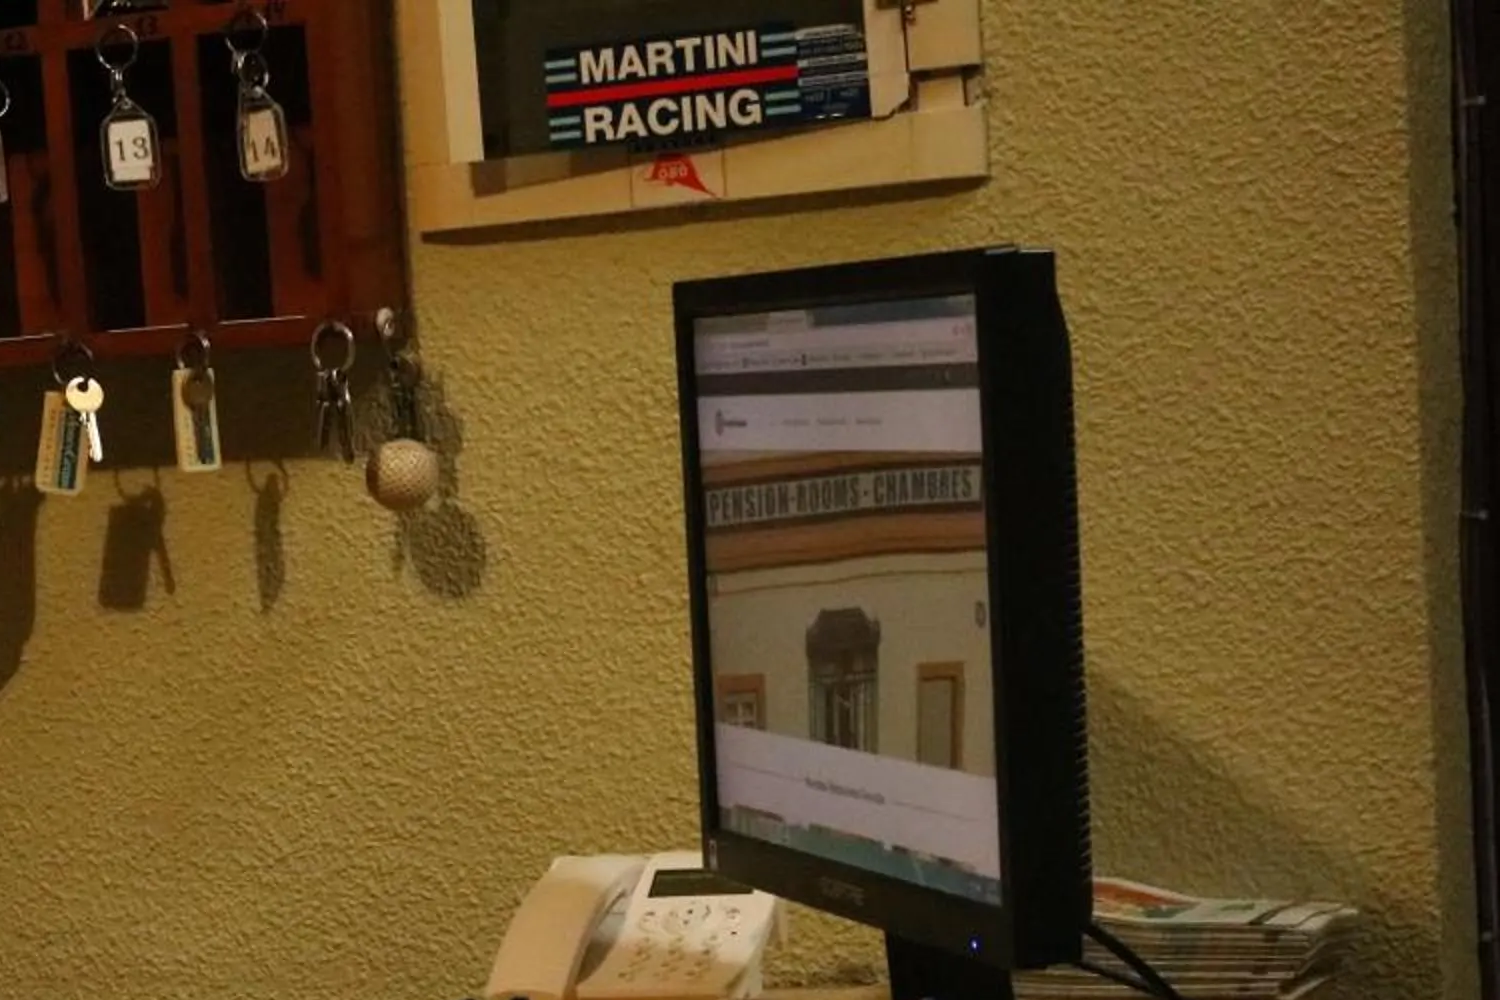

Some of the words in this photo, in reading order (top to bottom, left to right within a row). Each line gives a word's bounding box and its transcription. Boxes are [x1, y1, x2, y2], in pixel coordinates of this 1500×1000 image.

[578, 30, 758, 86] MARTINI
[583, 88, 762, 144] RACING
[114, 135, 149, 162] 13
[248, 138, 278, 163] 14
